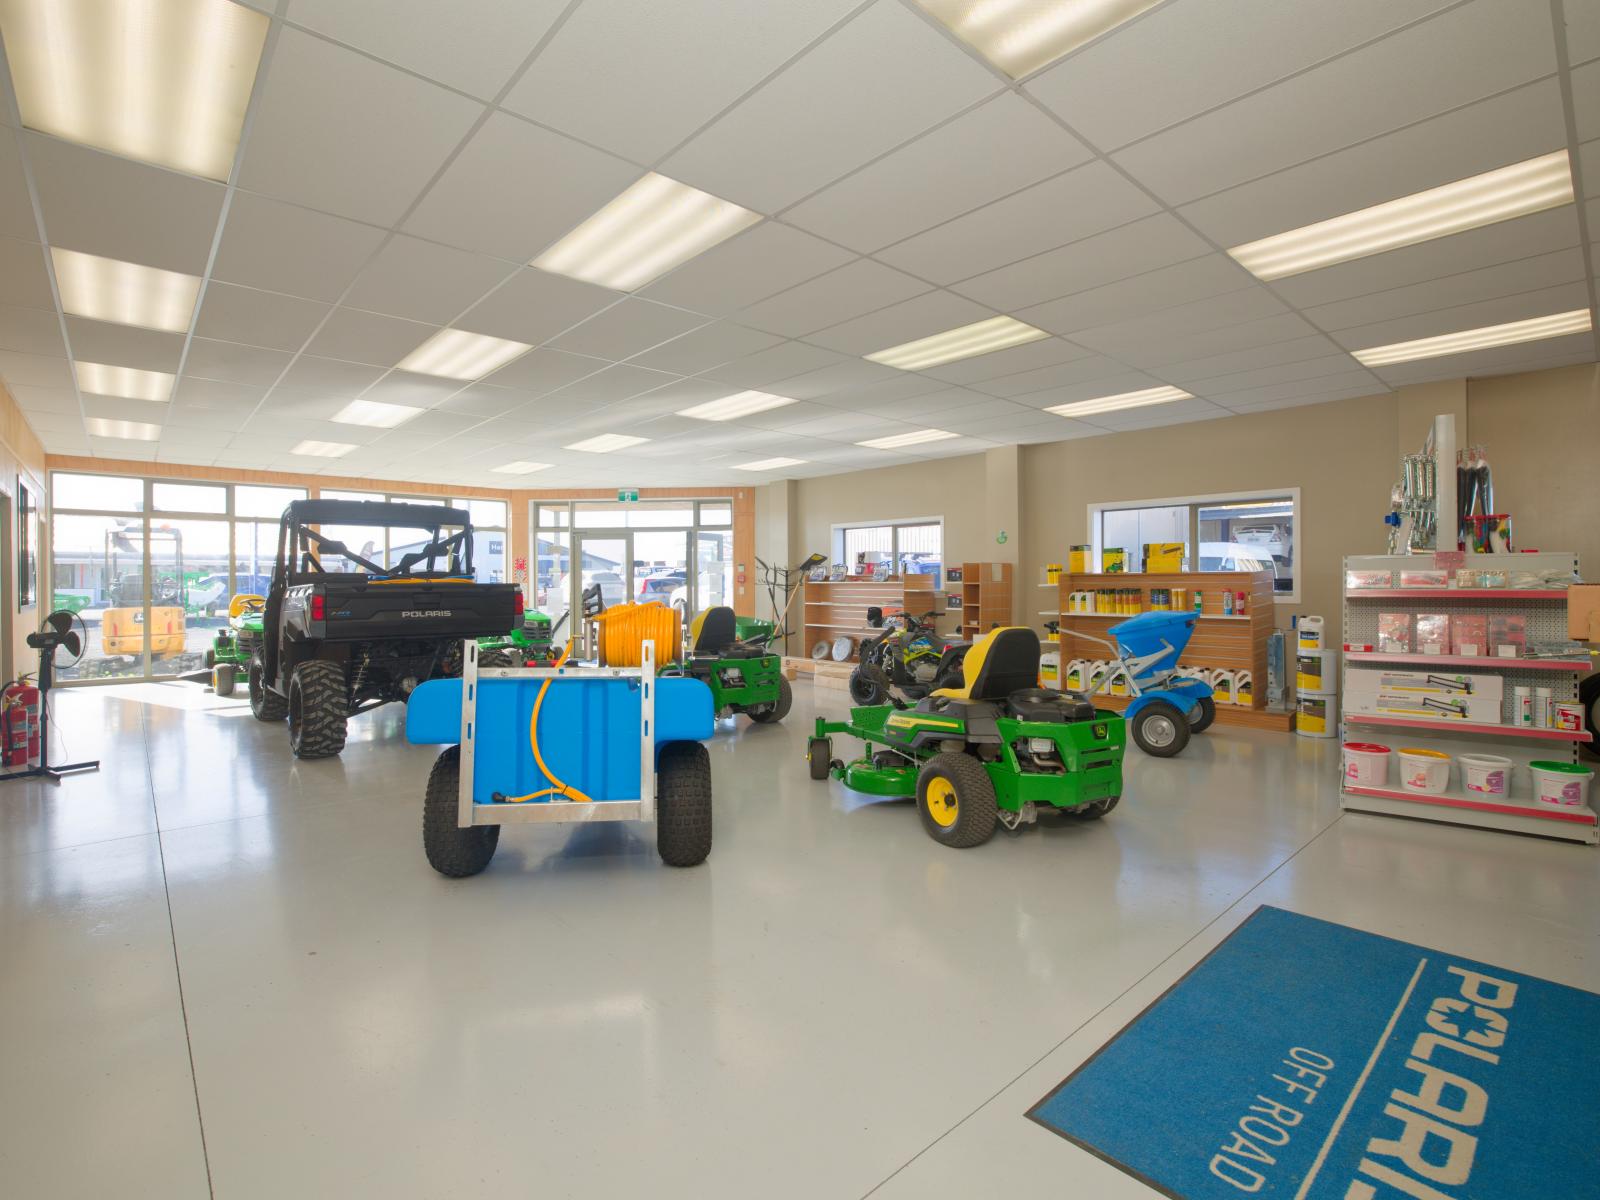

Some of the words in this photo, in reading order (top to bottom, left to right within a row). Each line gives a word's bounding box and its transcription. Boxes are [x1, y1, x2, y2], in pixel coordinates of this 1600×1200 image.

[401, 610, 452, 618] POLARIS
[1272, 1046, 1335, 1105] OFF
[1209, 1094, 1304, 1192] ROAD
